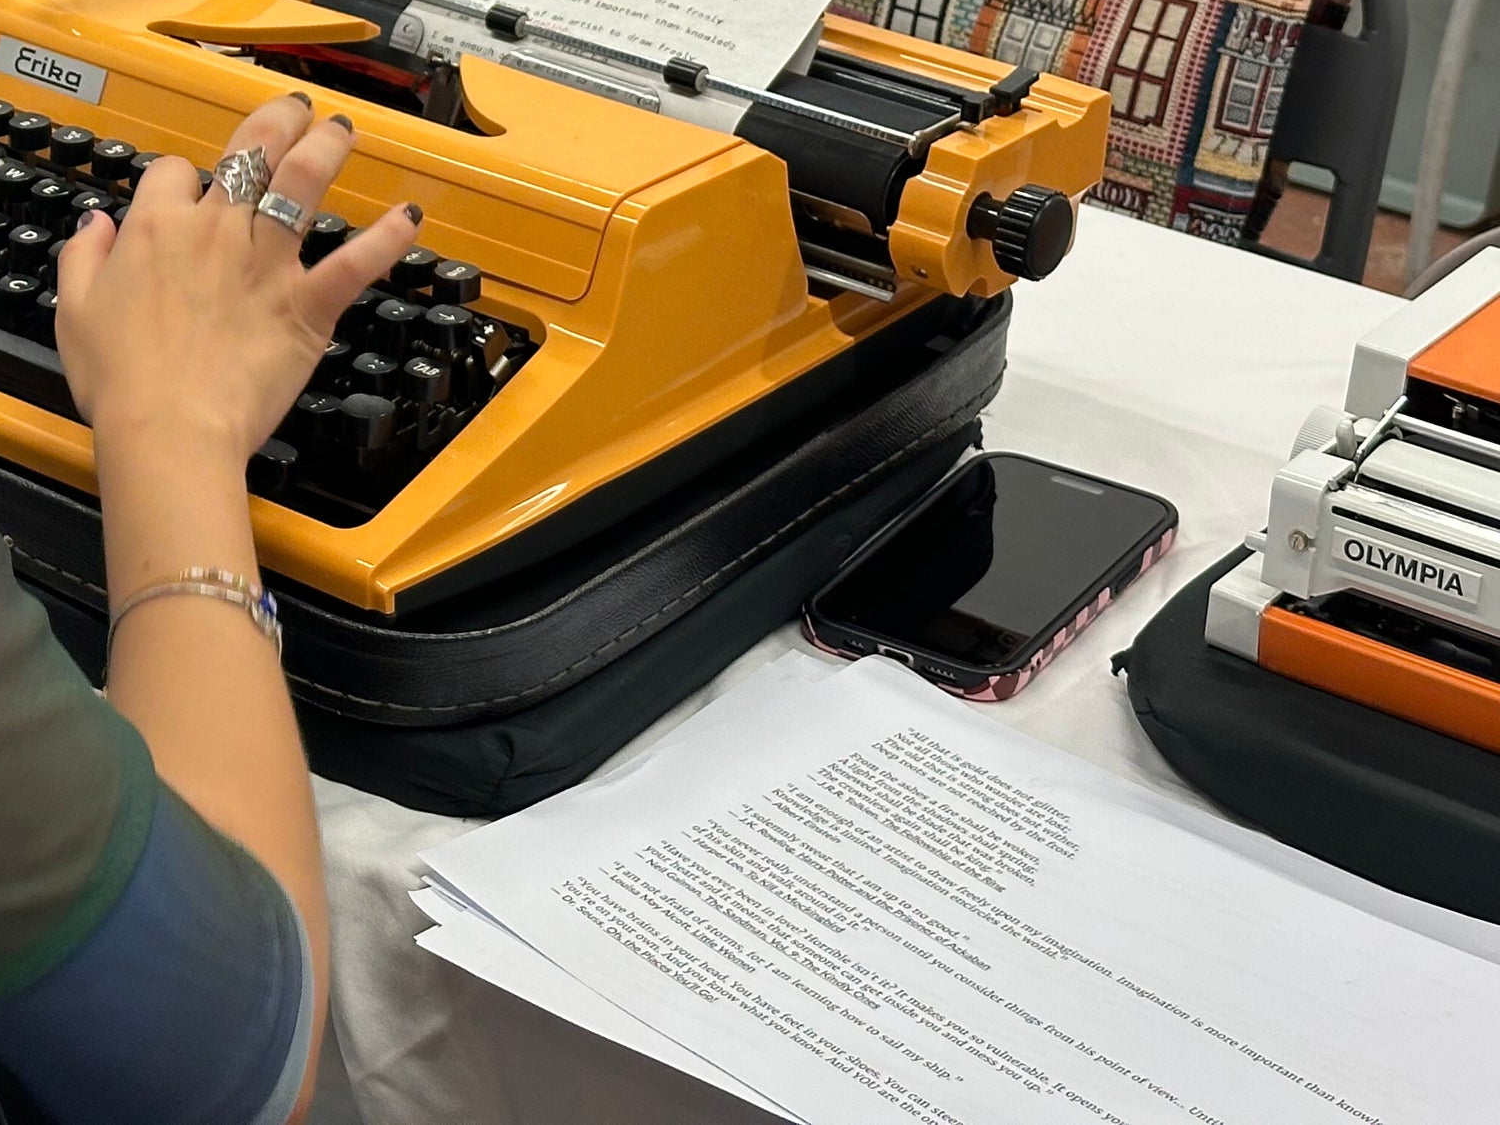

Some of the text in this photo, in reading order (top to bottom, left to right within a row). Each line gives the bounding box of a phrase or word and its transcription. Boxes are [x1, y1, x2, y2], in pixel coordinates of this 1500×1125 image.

[594, 0, 649, 20] important
[15, 47, 82, 92] Erika
[5, 167, 25, 178] W
[42, 185, 59, 194] E
[83, 197, 101, 206] R
[19, 230, 38, 239] D
[9, 279, 28, 289] C
[412, 361, 440, 376] TAB
[1343, 539, 1464, 597] OLYMPIA
[729, 836, 764, 857] never
[760, 855, 795, 875] really
[792, 874, 858, 914] understand
[859, 916, 903, 943] person
[902, 940, 934, 960] until
[927, 958, 955, 975] you
[953, 972, 1005, 1004] consider
[1003, 1002, 1044, 1027] things
[1042, 1024, 1075, 1045] from
[1074, 1041, 1097, 1057] his
[1092, 1054, 1132, 1076] point
[1130, 1074, 1150, 1085] of
[795, 792, 815, 805] am
[814, 803, 855, 829] enough
[854, 826, 872, 836] of
[866, 834, 884, 845] an
[882, 843, 915, 863] artist
[913, 860, 928, 871] to
[927, 869, 958, 887] draw
[955, 886, 992, 907] freely
[990, 905, 1021, 926] upon
[1020, 923, 1043, 937] my
[1115, 976, 1191, 1020] Imagination
[1190, 1017, 1205, 1028] is
[1203, 1026, 1239, 1047] more
[1237, 1044, 1305, 1084] important
[1303, 1082, 1336, 1103] than
[621, 870, 641, 883] am
[639, 881, 662, 896] not
[658, 894, 695, 917] afraid
[691, 915, 710, 926] of
[745, 951, 767, 965] for
[771, 967, 792, 981] am
[790, 978, 841, 1012] learning
[838, 1007, 867, 1027] how
[865, 1025, 880, 1036] to
[878, 1034, 906, 1050] sail
[901, 1048, 925, 1062] my
[599, 893, 627, 914] have
[625, 911, 661, 937] brains
[658, 935, 674, 947] in
[669, 944, 701, 964] your
[729, 980, 753, 998] You
[751, 994, 781, 1015] have
[779, 1013, 805, 1031] feet
[802, 1027, 818, 1039] in
[815, 1036, 848, 1056] your
[883, 1076, 909, 1095] You
[907, 1093, 931, 1109] can
[687, 861, 712, 877] you
[710, 875, 737, 891] ever
[734, 888, 763, 909] been
[760, 906, 776, 918] in
[773, 914, 808, 935] love?
[803, 933, 852, 965] Horrible
[877, 978, 899, 991] it?
[893, 989, 909, 999] It
[905, 997, 946, 1022] makes
[942, 1020, 970, 1036] you
[968, 1034, 985, 1045] so
[1051, 1082, 1067, 1093] It
[1064, 1091, 1105, 1115] opens
